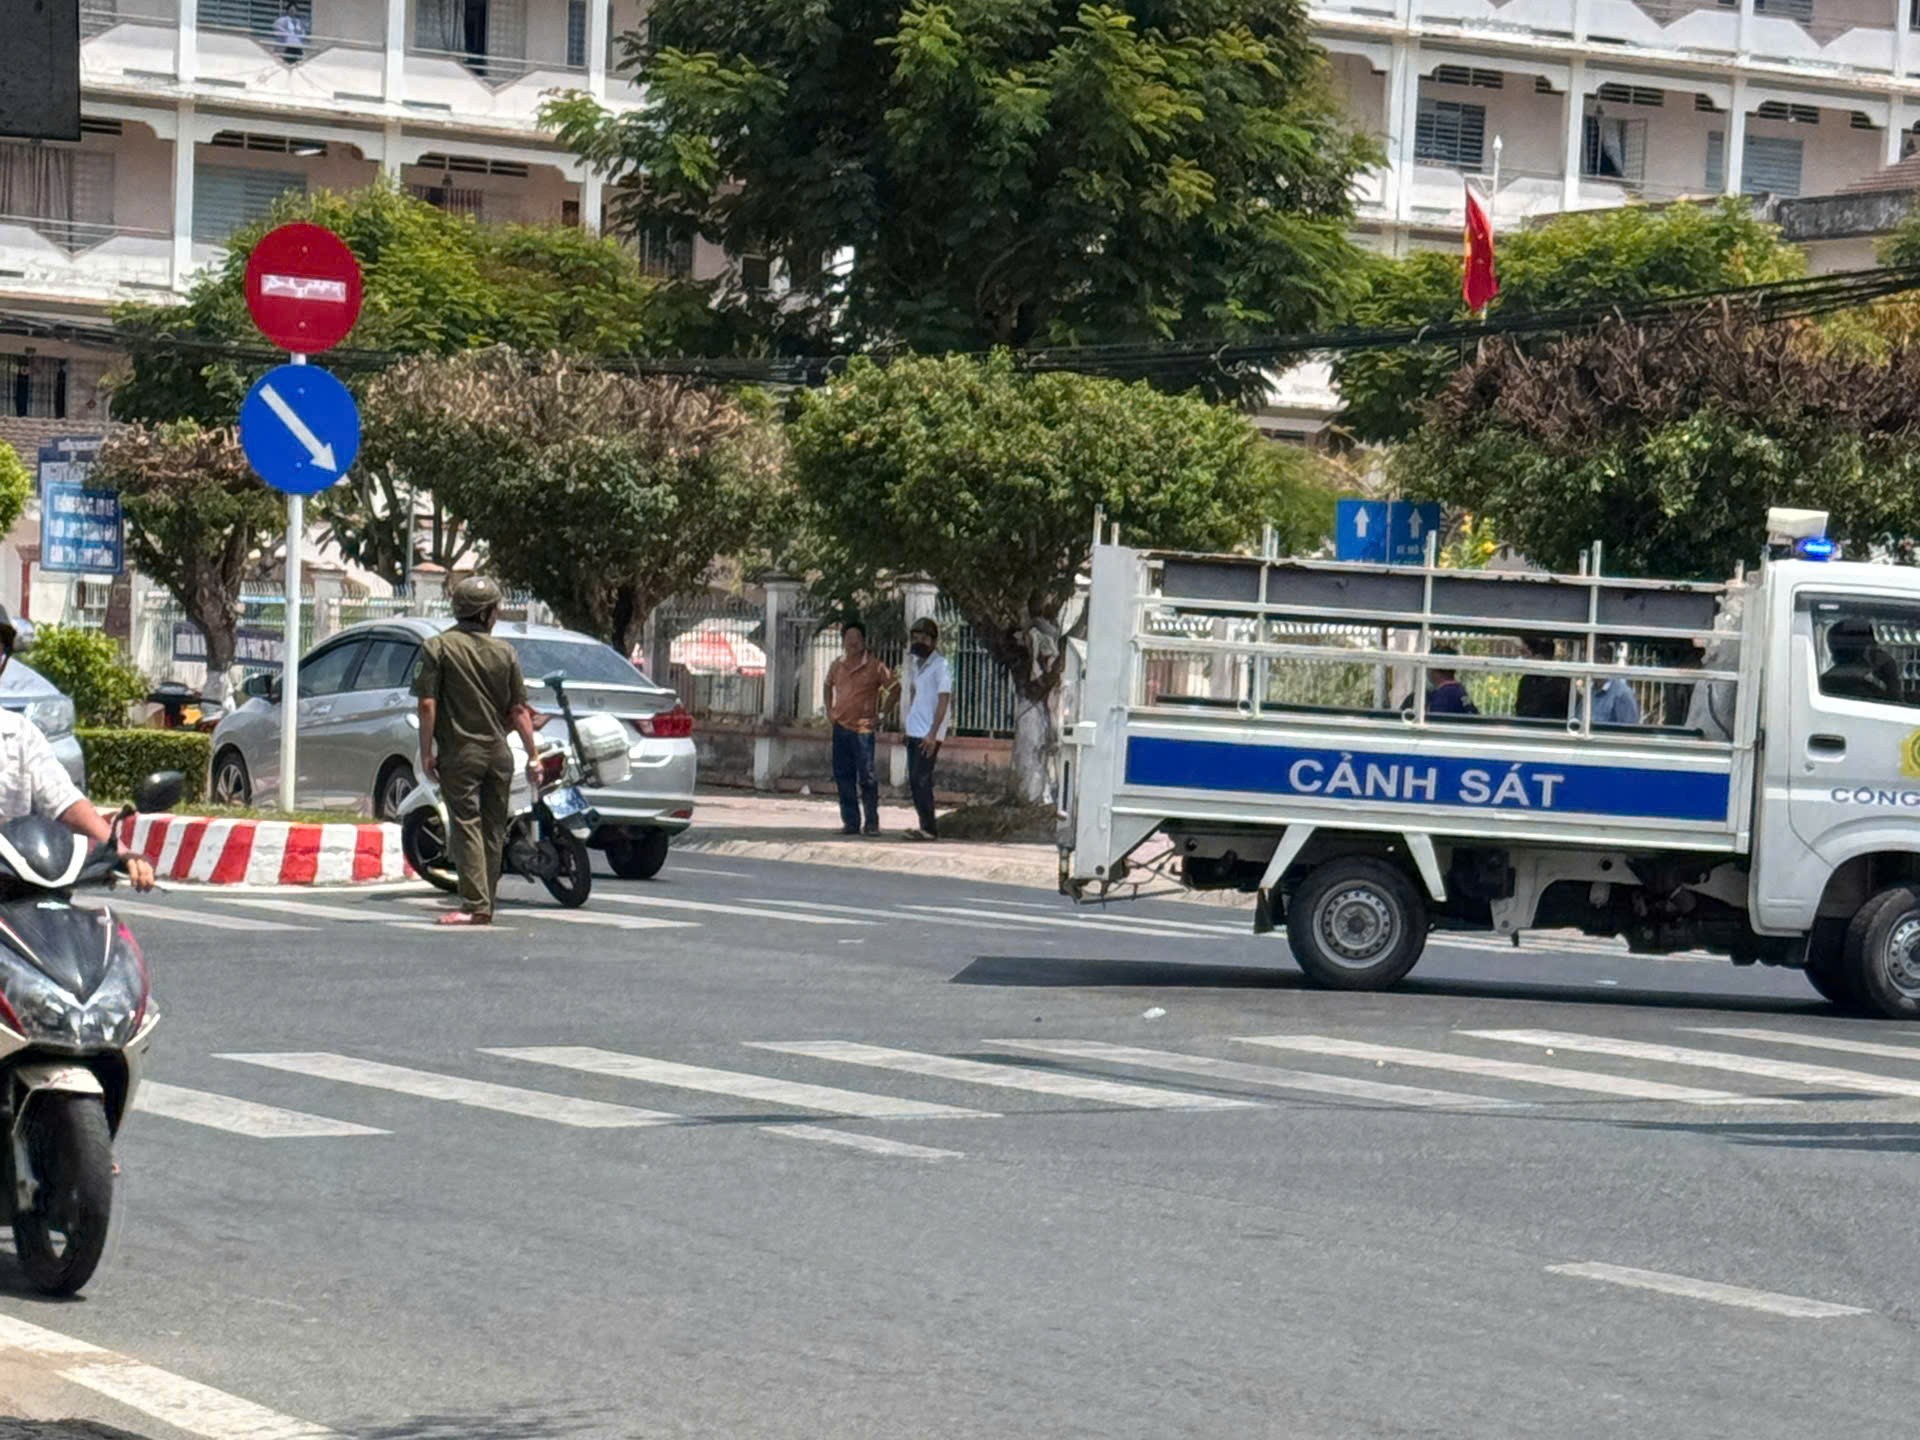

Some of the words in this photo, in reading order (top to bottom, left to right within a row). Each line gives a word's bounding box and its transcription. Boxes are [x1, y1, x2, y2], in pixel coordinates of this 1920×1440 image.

[1289, 754, 1438, 801] CẢNH
[1458, 763, 1566, 808] SÁT
[1831, 786, 1920, 806] CÔNG
